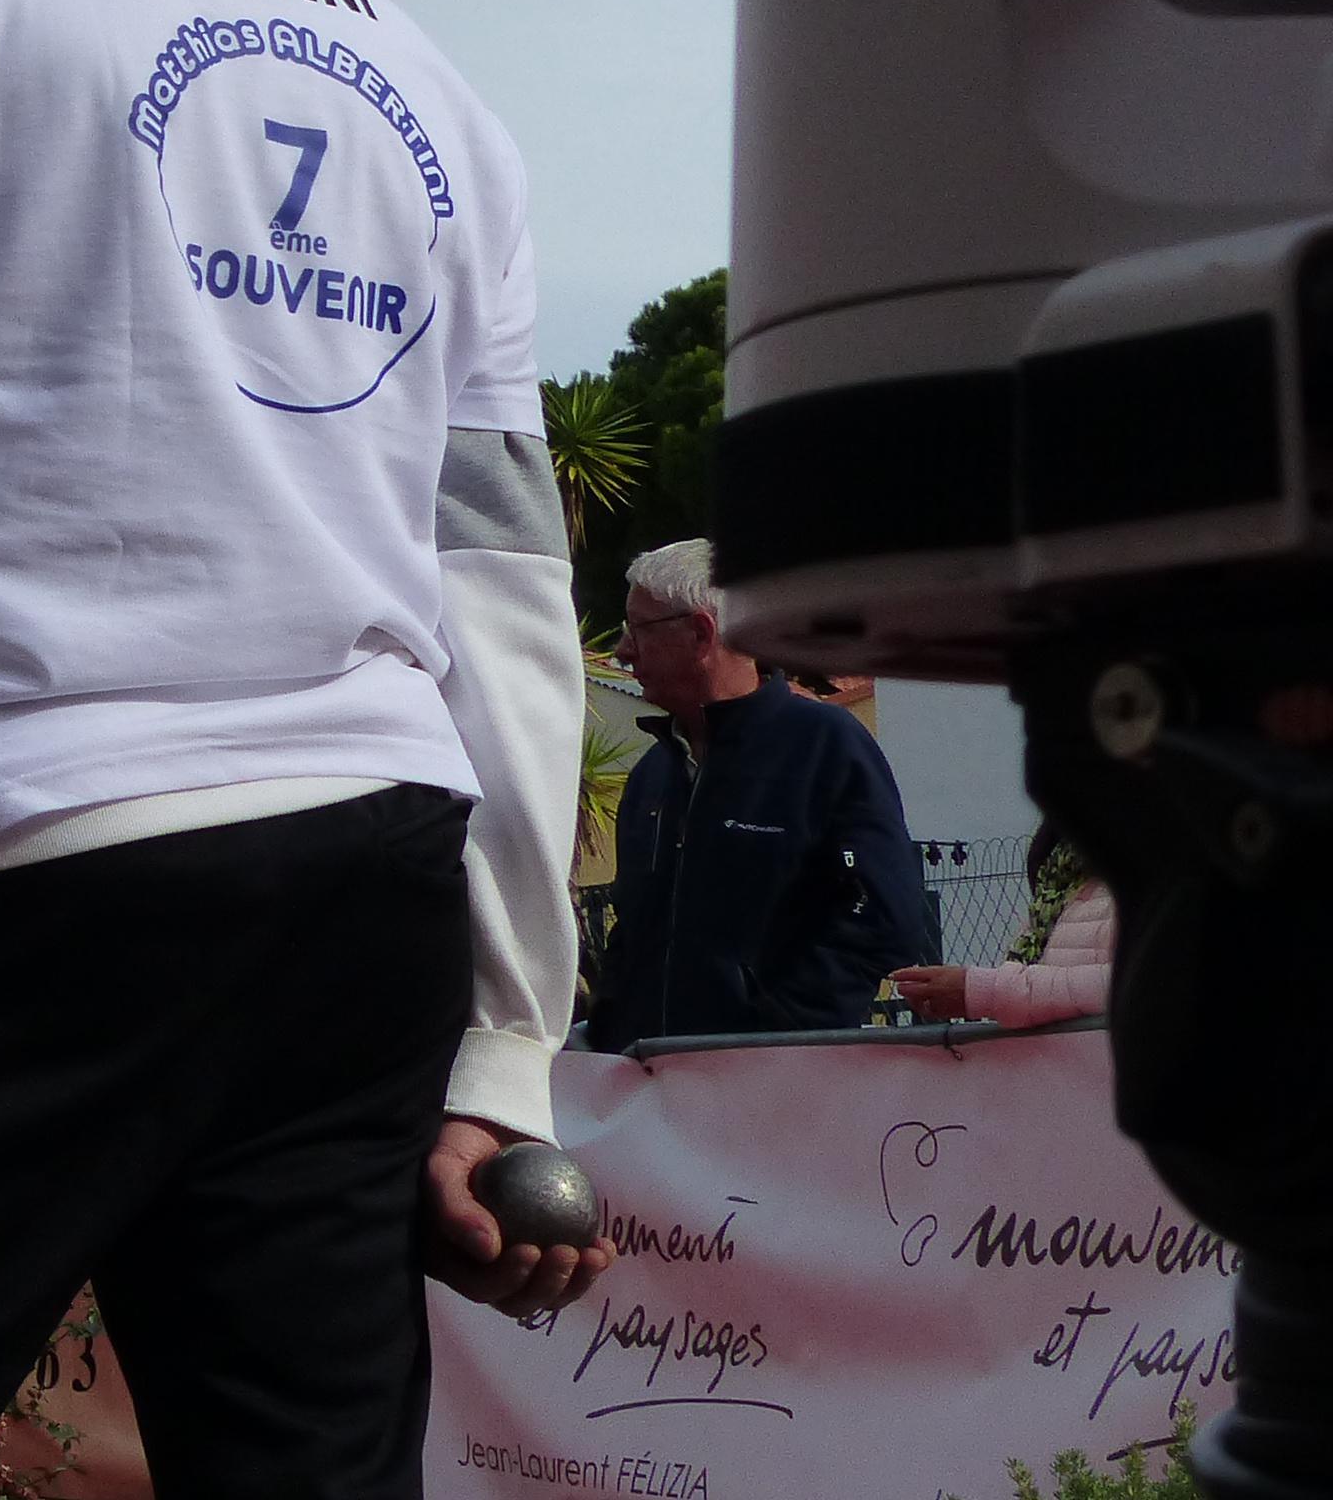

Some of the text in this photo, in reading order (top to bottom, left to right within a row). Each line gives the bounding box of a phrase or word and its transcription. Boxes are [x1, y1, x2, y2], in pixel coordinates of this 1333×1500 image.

[262, 117, 328, 231] 7
[185, 242, 407, 336] SOUVENIR
[573, 1297, 768, 1394] paysages
[1033, 1290, 1112, 1372] et
[457, 1433, 709, 1500] Jean-Laurent FÉLIZIA
